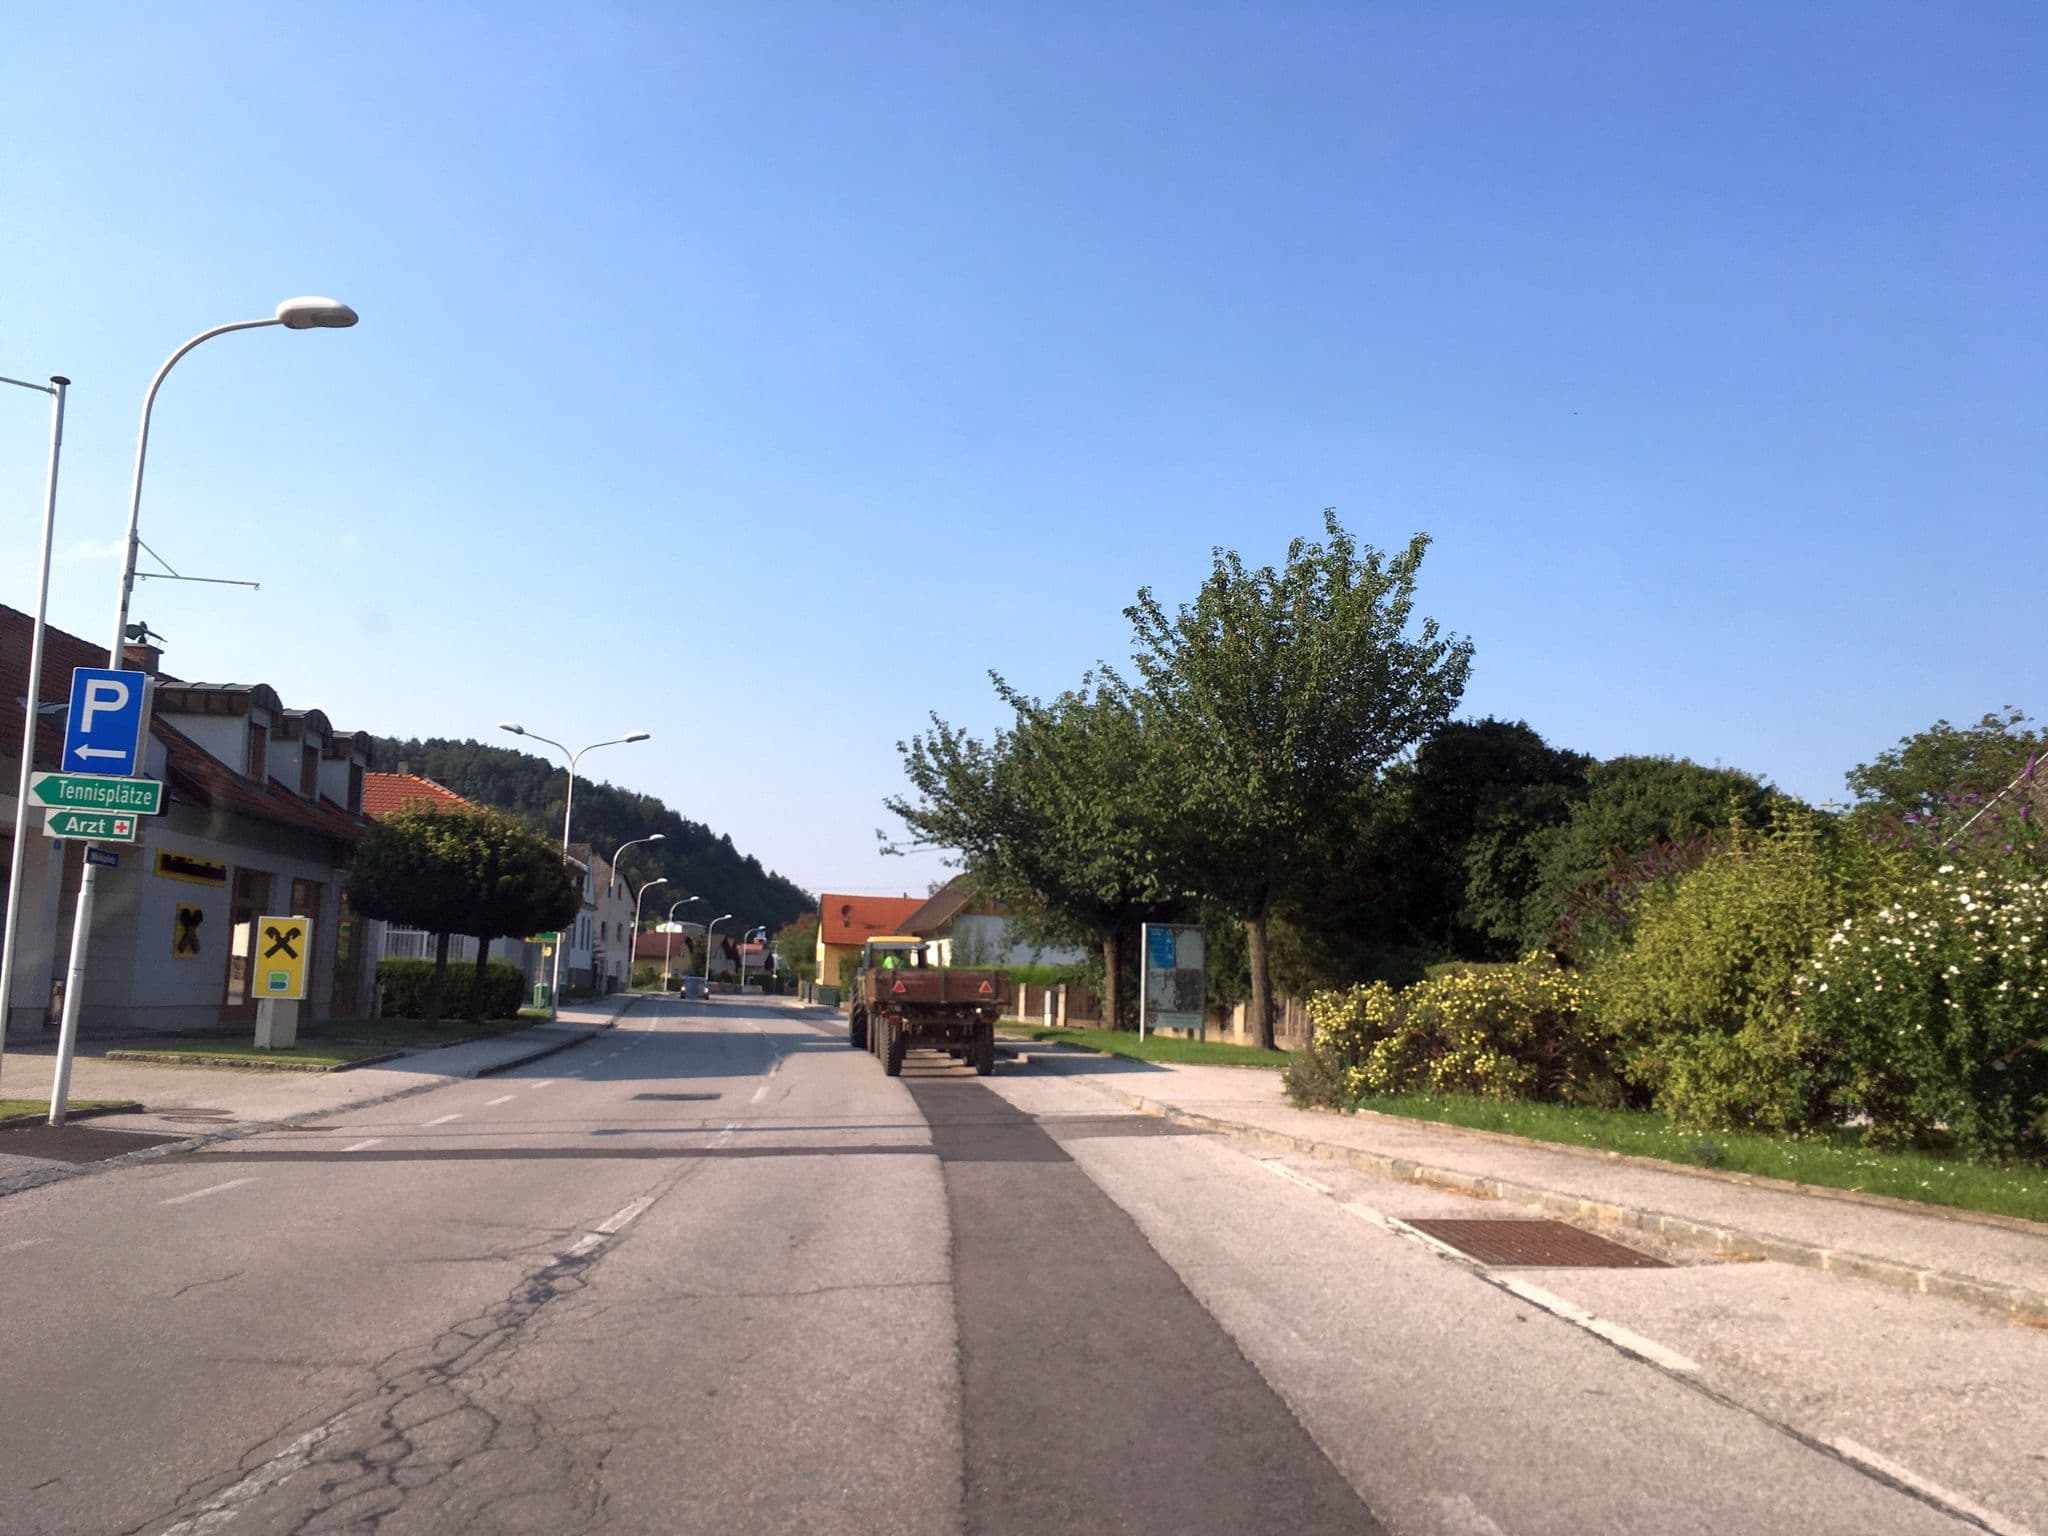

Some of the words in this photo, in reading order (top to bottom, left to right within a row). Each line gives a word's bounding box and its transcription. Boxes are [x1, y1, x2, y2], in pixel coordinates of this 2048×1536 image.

[80, 678, 129, 733] P
[59, 780, 152, 807] Tennisplätze
[65, 816, 105, 834] Arzt
